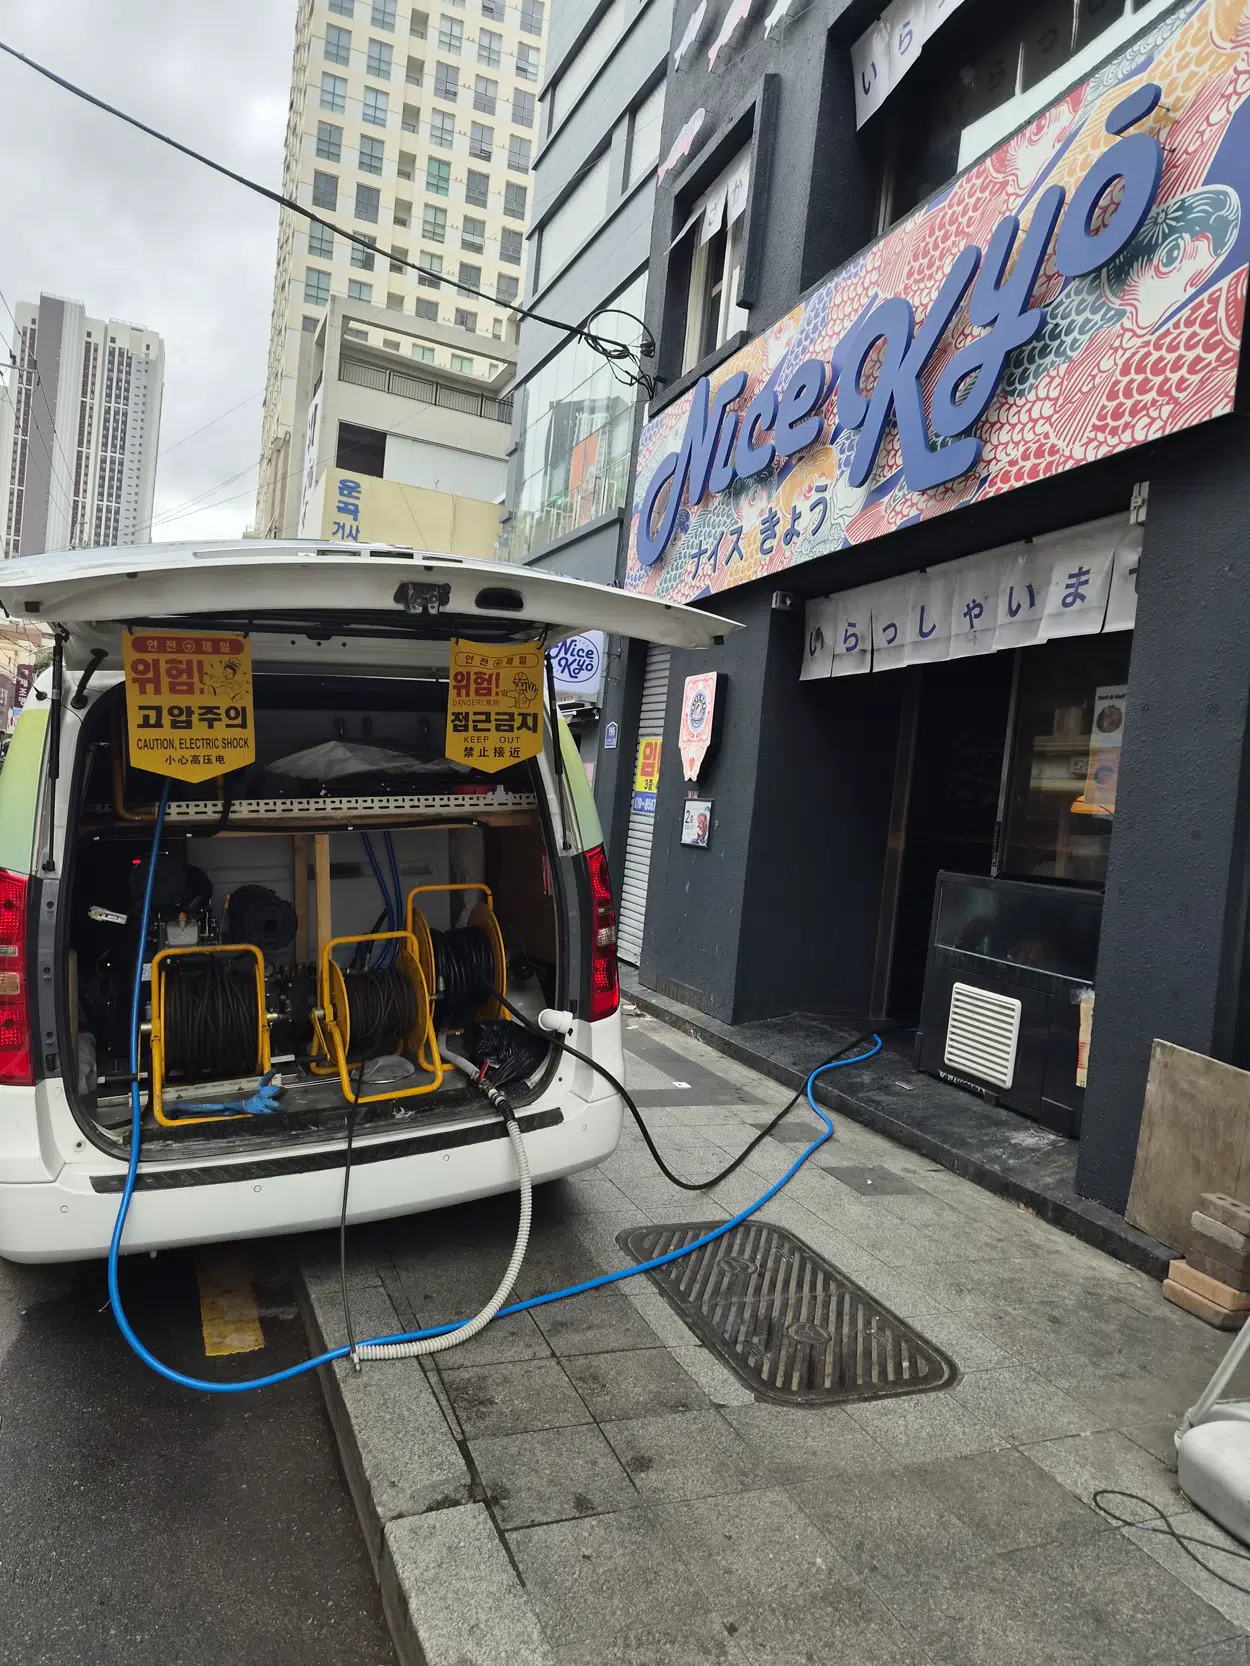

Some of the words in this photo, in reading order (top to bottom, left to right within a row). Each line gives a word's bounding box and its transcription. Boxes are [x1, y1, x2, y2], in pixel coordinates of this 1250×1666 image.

[636, 359, 827, 567] Nice
[690, 525, 744, 580] ナイス
[759, 484, 829, 556] きょう
[808, 566, 1137, 657] いらっしゃいま
[146, 640, 177, 652] 안전
[548, 639, 594, 660] Nice
[130, 658, 205, 696] 위험!
[453, 671, 501, 698] 위험!
[137, 705, 248, 730] 고압주의
[451, 711, 539, 734] 접근금지
[136, 738, 177, 751] CAUTION,
[179, 738, 220, 750] ELECTRIC
[221, 737, 250, 749] SHOCK
[463, 736, 489, 744] KEEP
[499, 735, 521, 744] OUT
[165, 754, 226, 766] 小心高压电
[463, 746, 521, 759] 禁止接近
